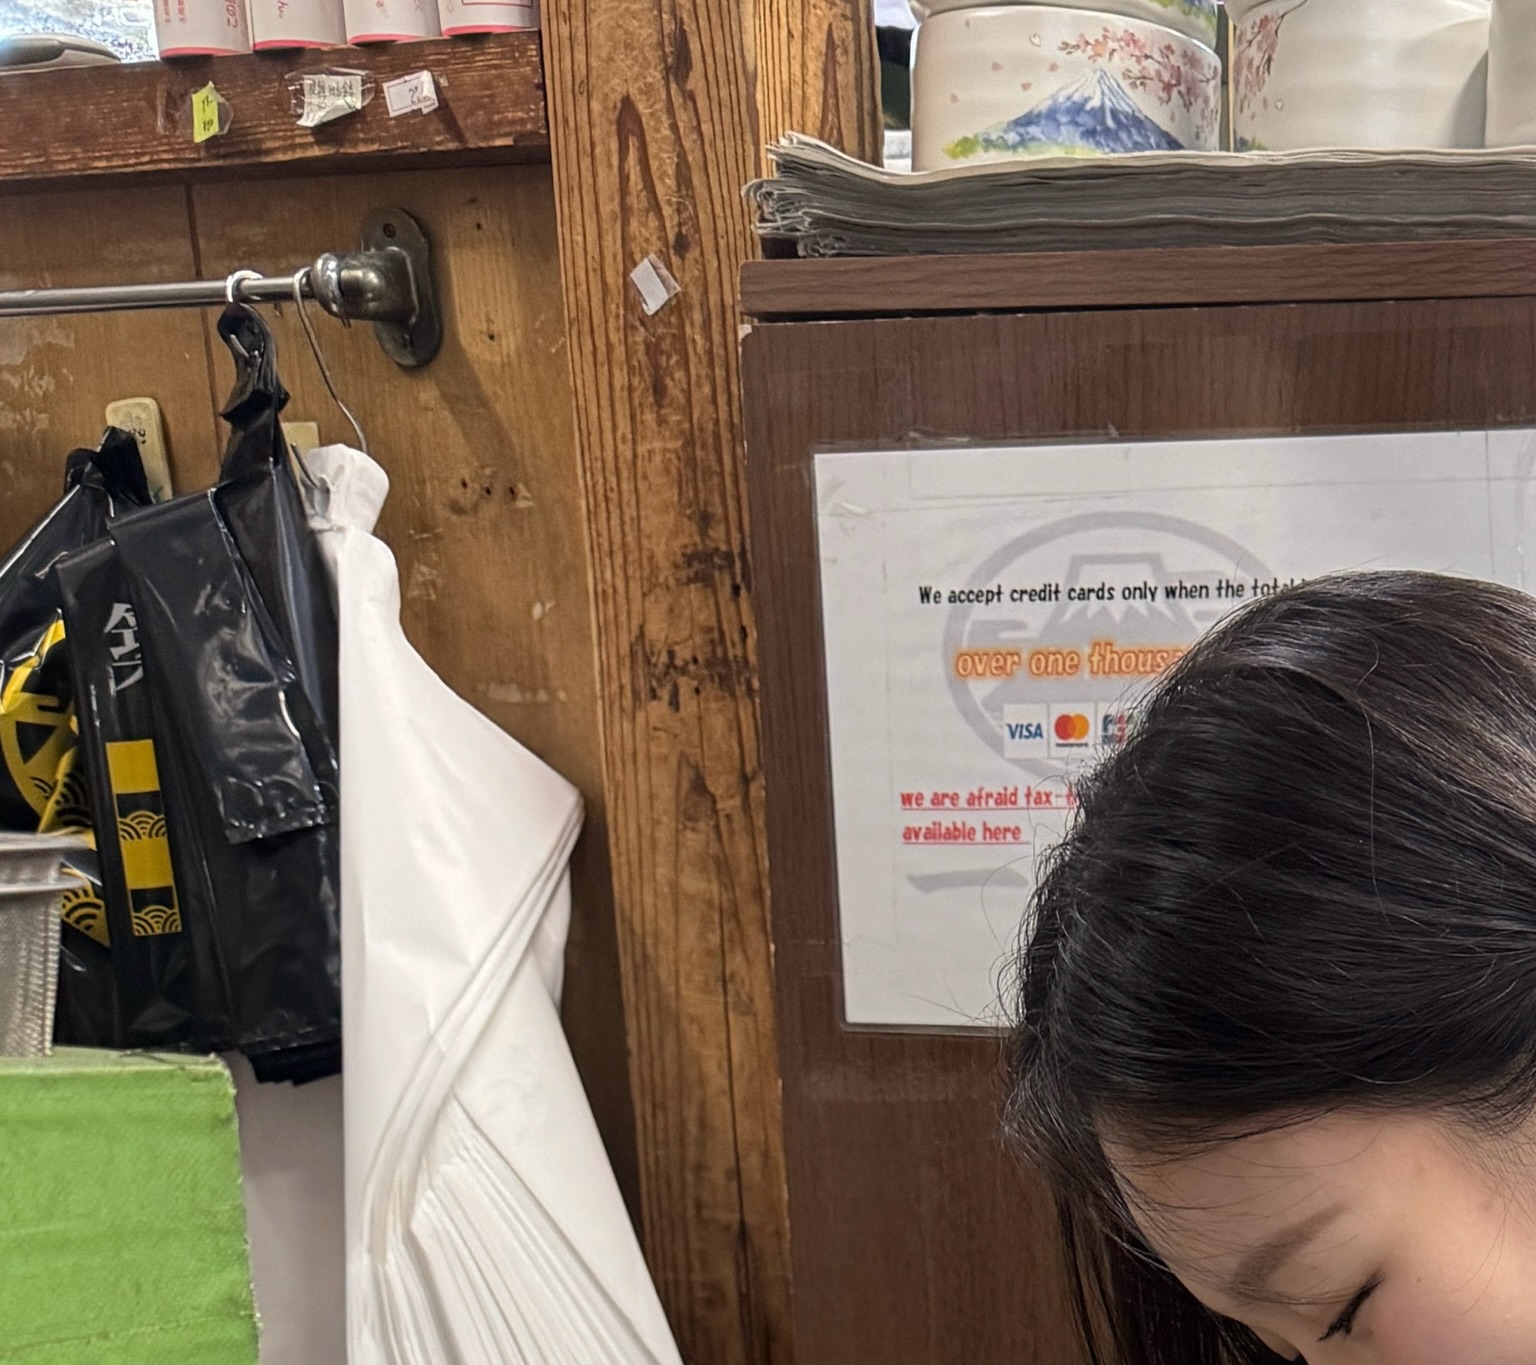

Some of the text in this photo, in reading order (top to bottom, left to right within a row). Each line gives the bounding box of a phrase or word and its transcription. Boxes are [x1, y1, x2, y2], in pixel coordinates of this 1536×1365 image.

[919, 586, 942, 604] We
[948, 584, 1003, 606] accept
[1010, 583, 1061, 602] credit
[1067, 582, 1115, 601] cards
[1122, 581, 1157, 601] only
[1164, 580, 1210, 599] when
[1216, 579, 1245, 598] the
[956, 651, 1021, 678] over
[1029, 650, 1080, 676] one
[1006, 722, 1043, 740] VISA
[900, 791, 924, 807] we
[930, 791, 959, 807] are
[966, 786, 1018, 807] afraid
[902, 821, 1021, 841] available here
